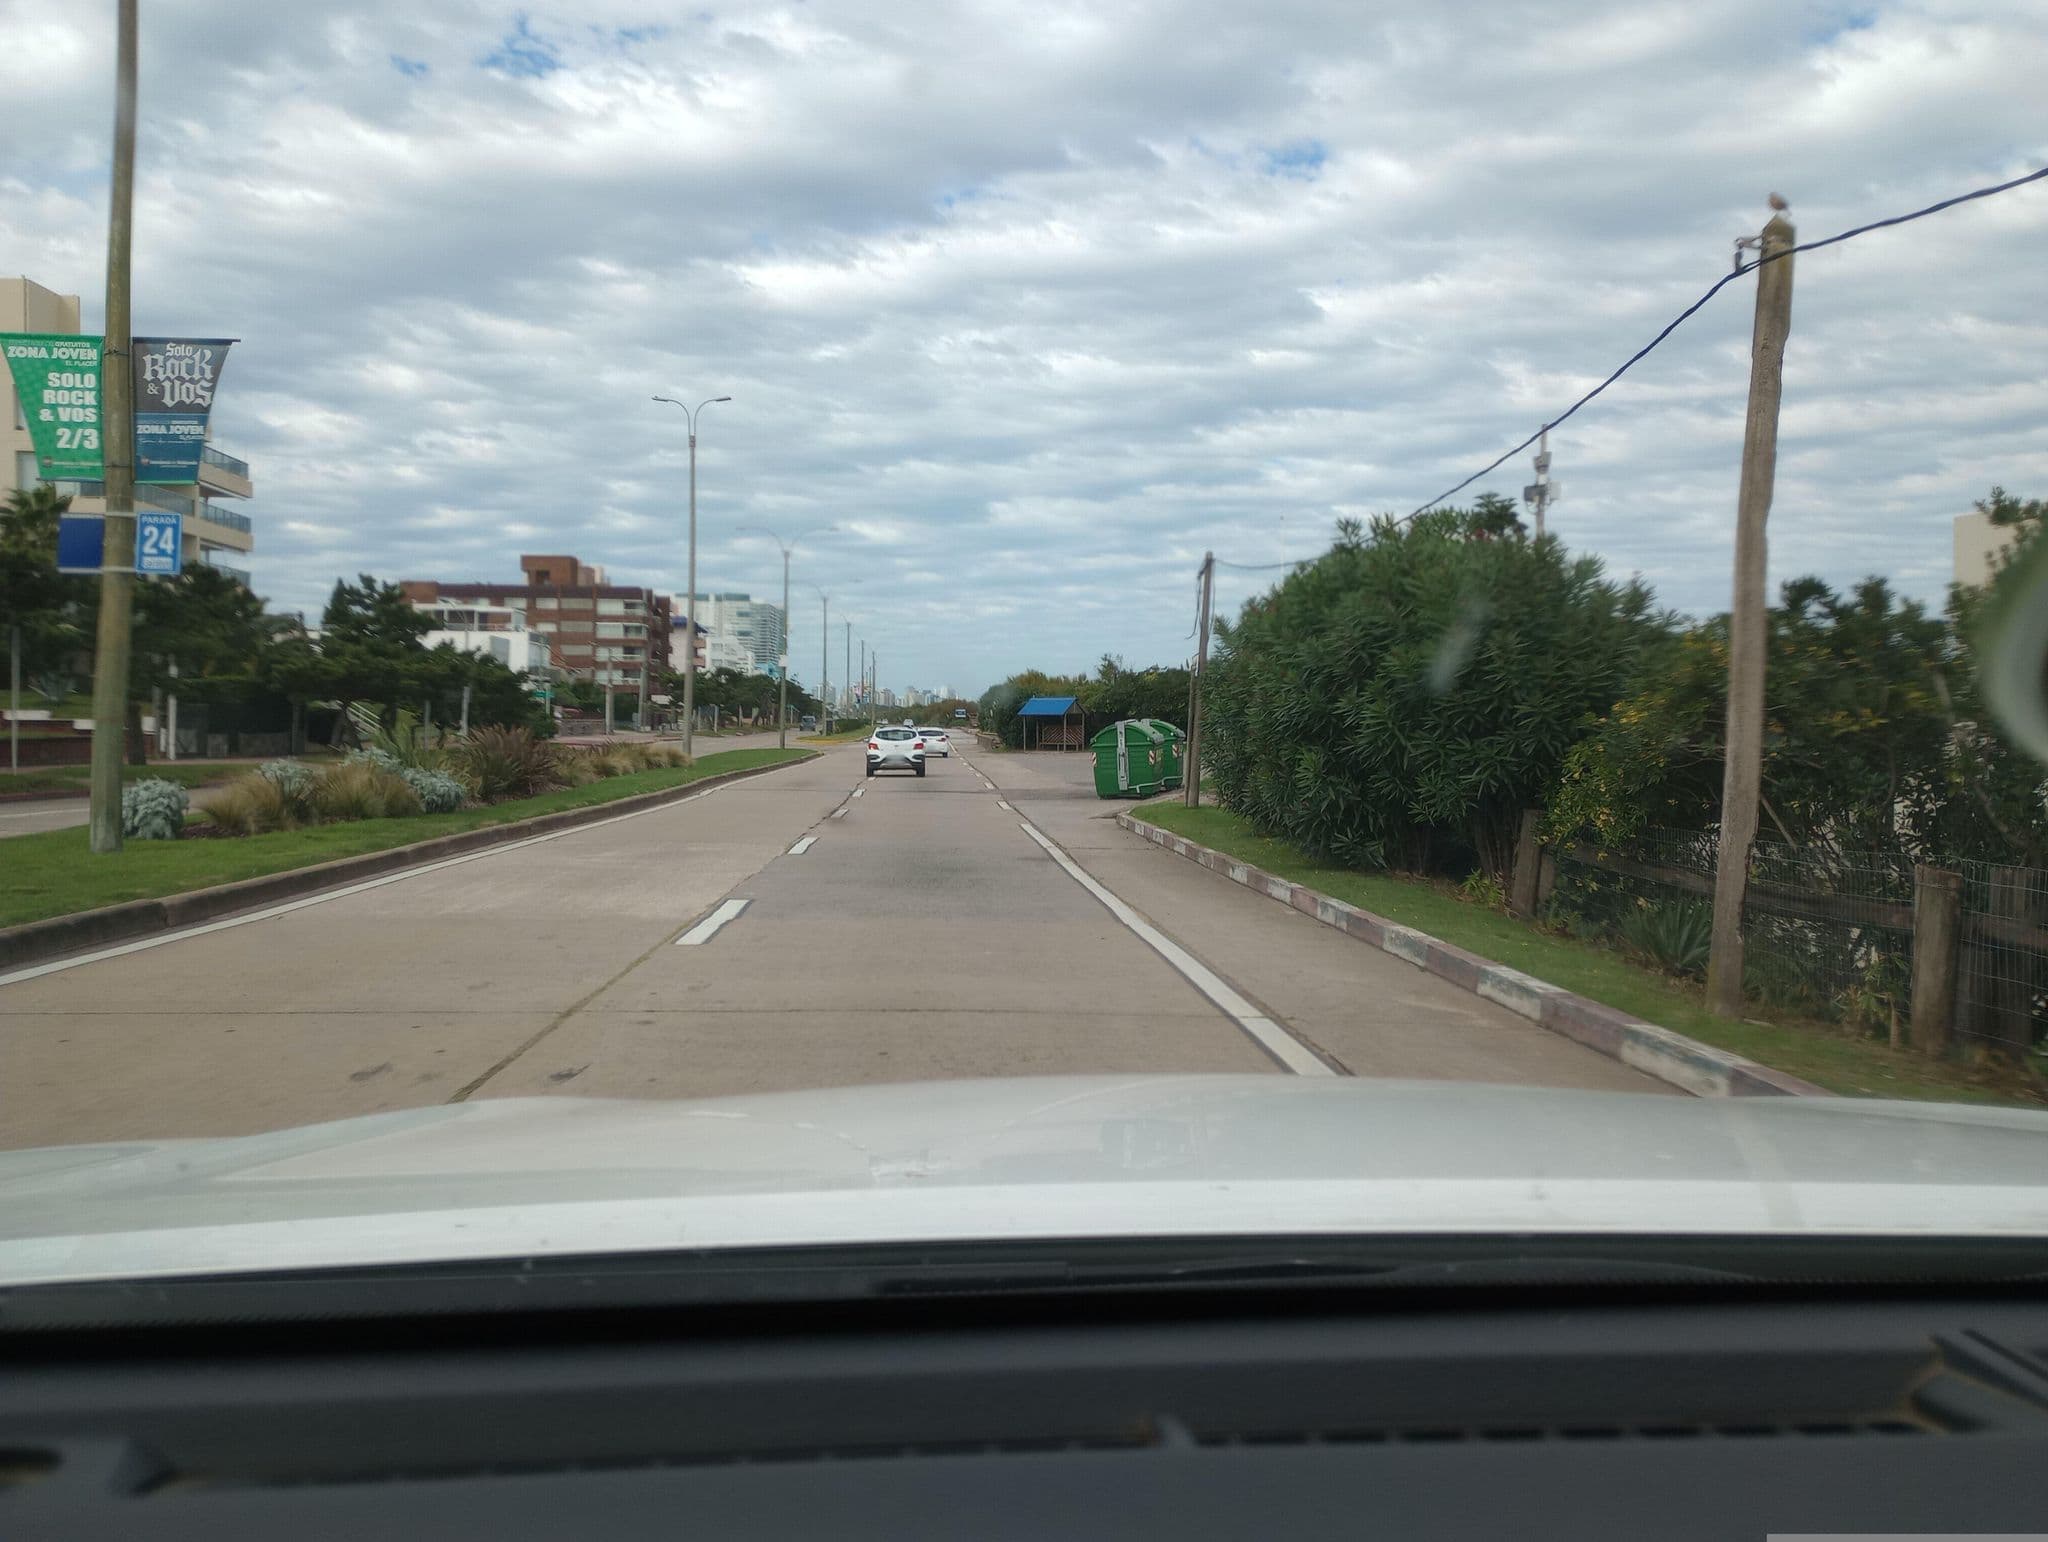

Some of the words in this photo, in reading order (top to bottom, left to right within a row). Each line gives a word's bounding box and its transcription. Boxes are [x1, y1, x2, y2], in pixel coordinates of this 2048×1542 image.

[7, 345, 49, 359] ZONA
[51, 347, 98, 361] JOVEN
[165, 342, 193, 357] Solo
[47, 372, 96, 389] SOLO
[147, 382, 160, 395] &
[43, 389, 98, 406] ROCK
[39, 408, 55, 422] &
[57, 407, 98, 423] VOS
[136, 424, 168, 435] ZONA
[168, 425, 205, 436] JOVEN
[56, 427, 99, 450] 2/3
[141, 515, 177, 525] PARADA
[143, 526, 175, 555] 24
